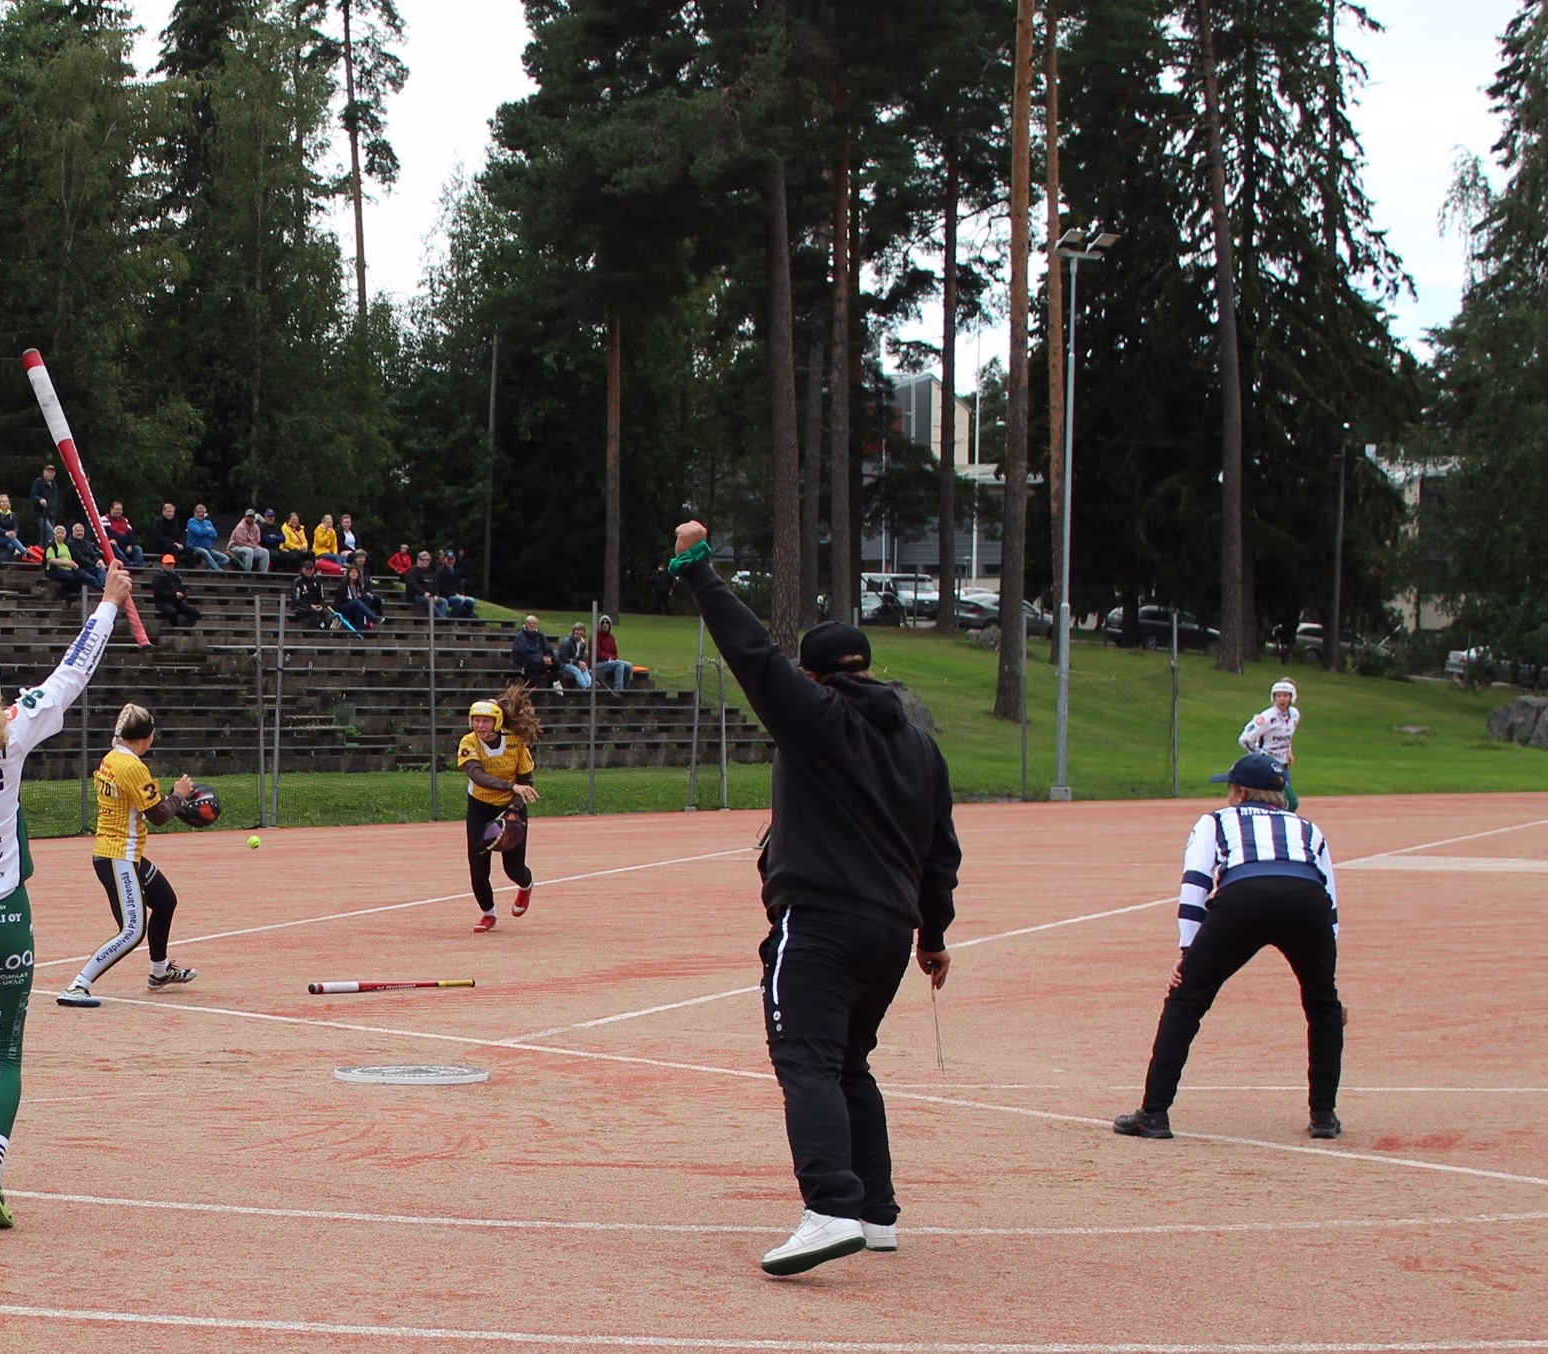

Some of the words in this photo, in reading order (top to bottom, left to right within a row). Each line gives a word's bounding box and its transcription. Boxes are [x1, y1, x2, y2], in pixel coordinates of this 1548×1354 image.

[144, 783, 157, 800] 3
[121, 871, 136, 909] Järvenpää
[8, 913, 22, 923] OY
[127, 909, 137, 929] Pauli
[95, 929, 135, 963] Kuvapalvelu
